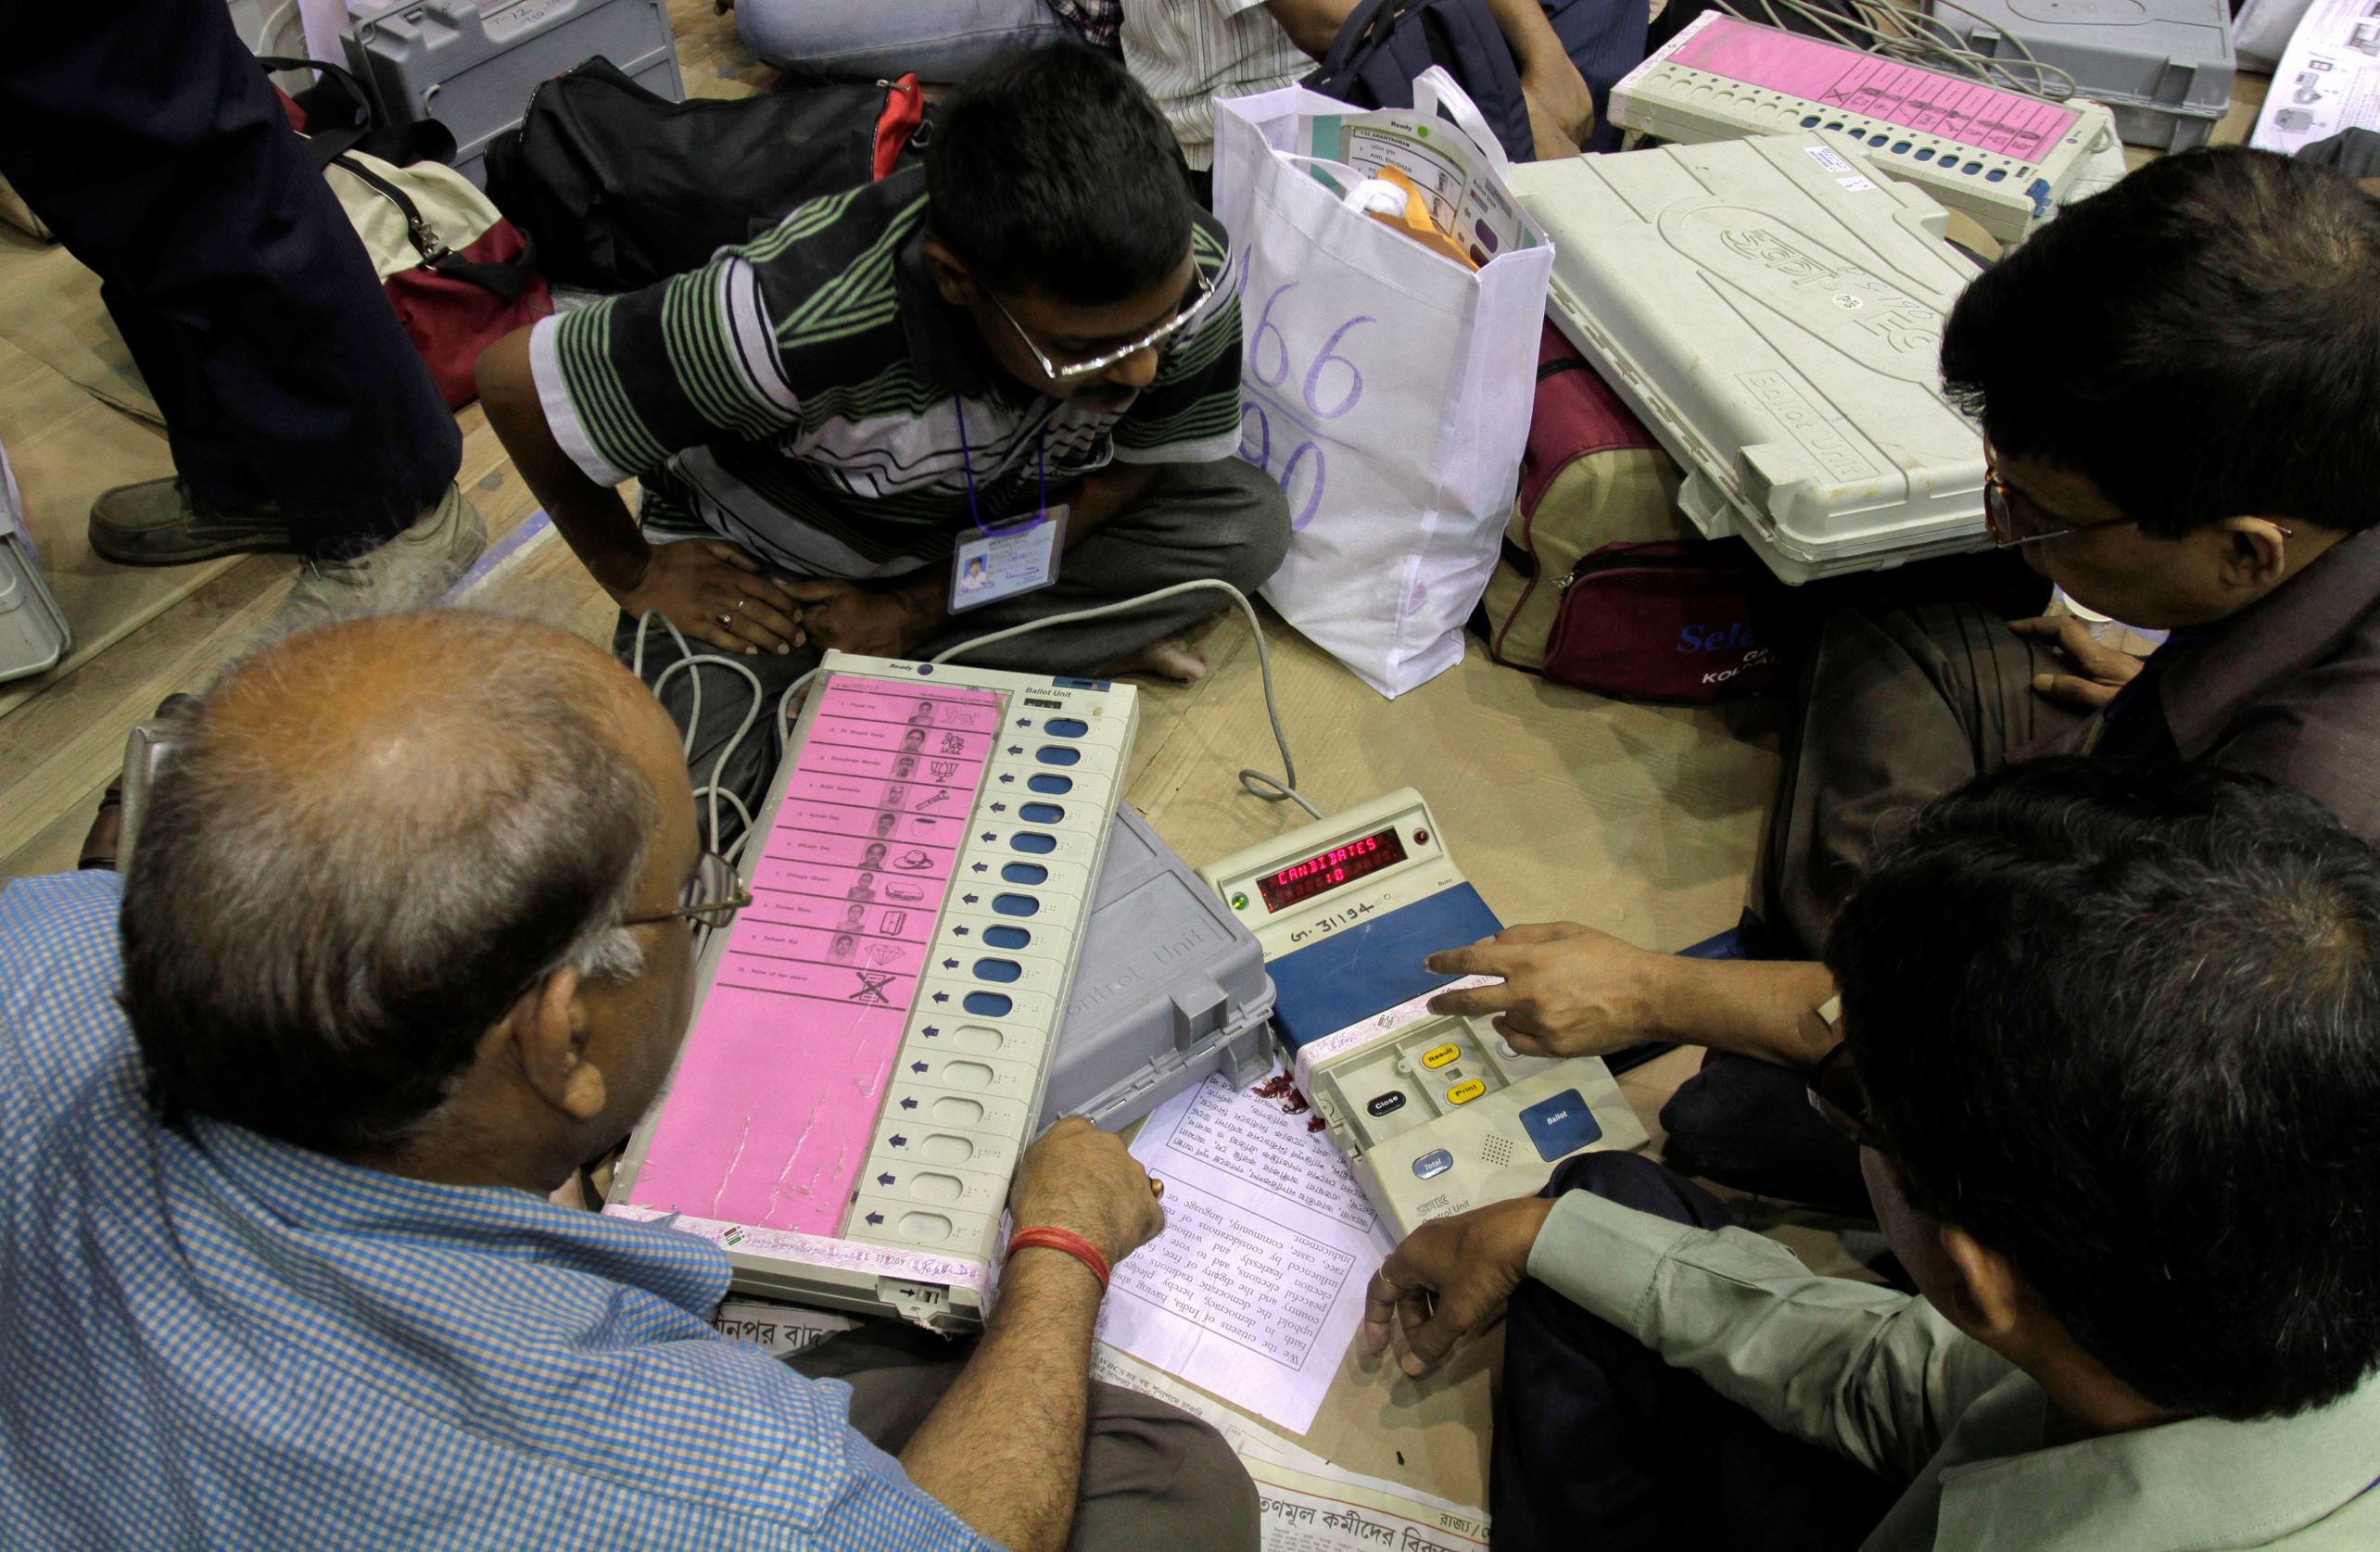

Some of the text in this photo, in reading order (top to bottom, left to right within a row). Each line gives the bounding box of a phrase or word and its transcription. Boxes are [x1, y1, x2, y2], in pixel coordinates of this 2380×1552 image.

[1391, 120, 1412, 132] Ready
[1749, 375, 1859, 475] Ballot Unit
[890, 663, 913, 672] Ready
[1025, 688, 1052, 696] Ballot
[1278, 836, 1377, 886] CANDIDATES
[1152, 926, 1205, 966] Unit
[1427, 1047, 1453, 1063] Result
[1455, 1083, 1477, 1097] Print
[1375, 1093, 1399, 1109] Close
[1547, 1110, 1568, 1126] Ballot
[1424, 1158, 1442, 1171] Total
[1453, 1201, 1470, 1212] Unit
[1178, 1213, 1192, 1225] of
[1166, 1192, 1344, 1277] race, caste, community, language or
[1196, 1221, 1264, 1256] considerations
[1170, 1237, 1191, 1252] vote
[1291, 1233, 1350, 1265] inducement.
[1159, 1246, 1183, 1264] free,
[1164, 1220, 1332, 1301] election fearlessly and without
[1196, 1249, 1207, 1259] to
[1268, 1251, 1283, 1266] by
[1148, 1257, 1194, 1284] traditions
[1184, 1259, 1197, 1271] of
[1211, 1256, 1230, 1271] and
[1200, 1264, 1235, 1288] dignity
[1234, 1266, 1281, 1293] elections,
[1286, 1260, 1338, 1290] influenced
[1133, 1281, 1168, 1304] having
[1197, 1281, 1251, 1311] democratic
[1236, 1282, 1254, 1297] the
[1120, 1258, 1307, 1351] faith in democracy, hereby pledge
[1171, 1297, 1201, 1319] India,
[1258, 1292, 1278, 1307] and
[1284, 1287, 1327, 1314] peaceful
[1201, 1312, 1215, 1325] of
[1255, 1306, 1272, 1320] the
[1281, 1300, 1321, 1326] country
[1218, 1319, 1257, 1346] citizens
[1276, 1314, 1314, 1339] uphold
[1259, 1339, 1277, 1356] the
[1279, 1349, 1300, 1368] We
[1323, 1509, 1397, 1547] কর্মীদের
